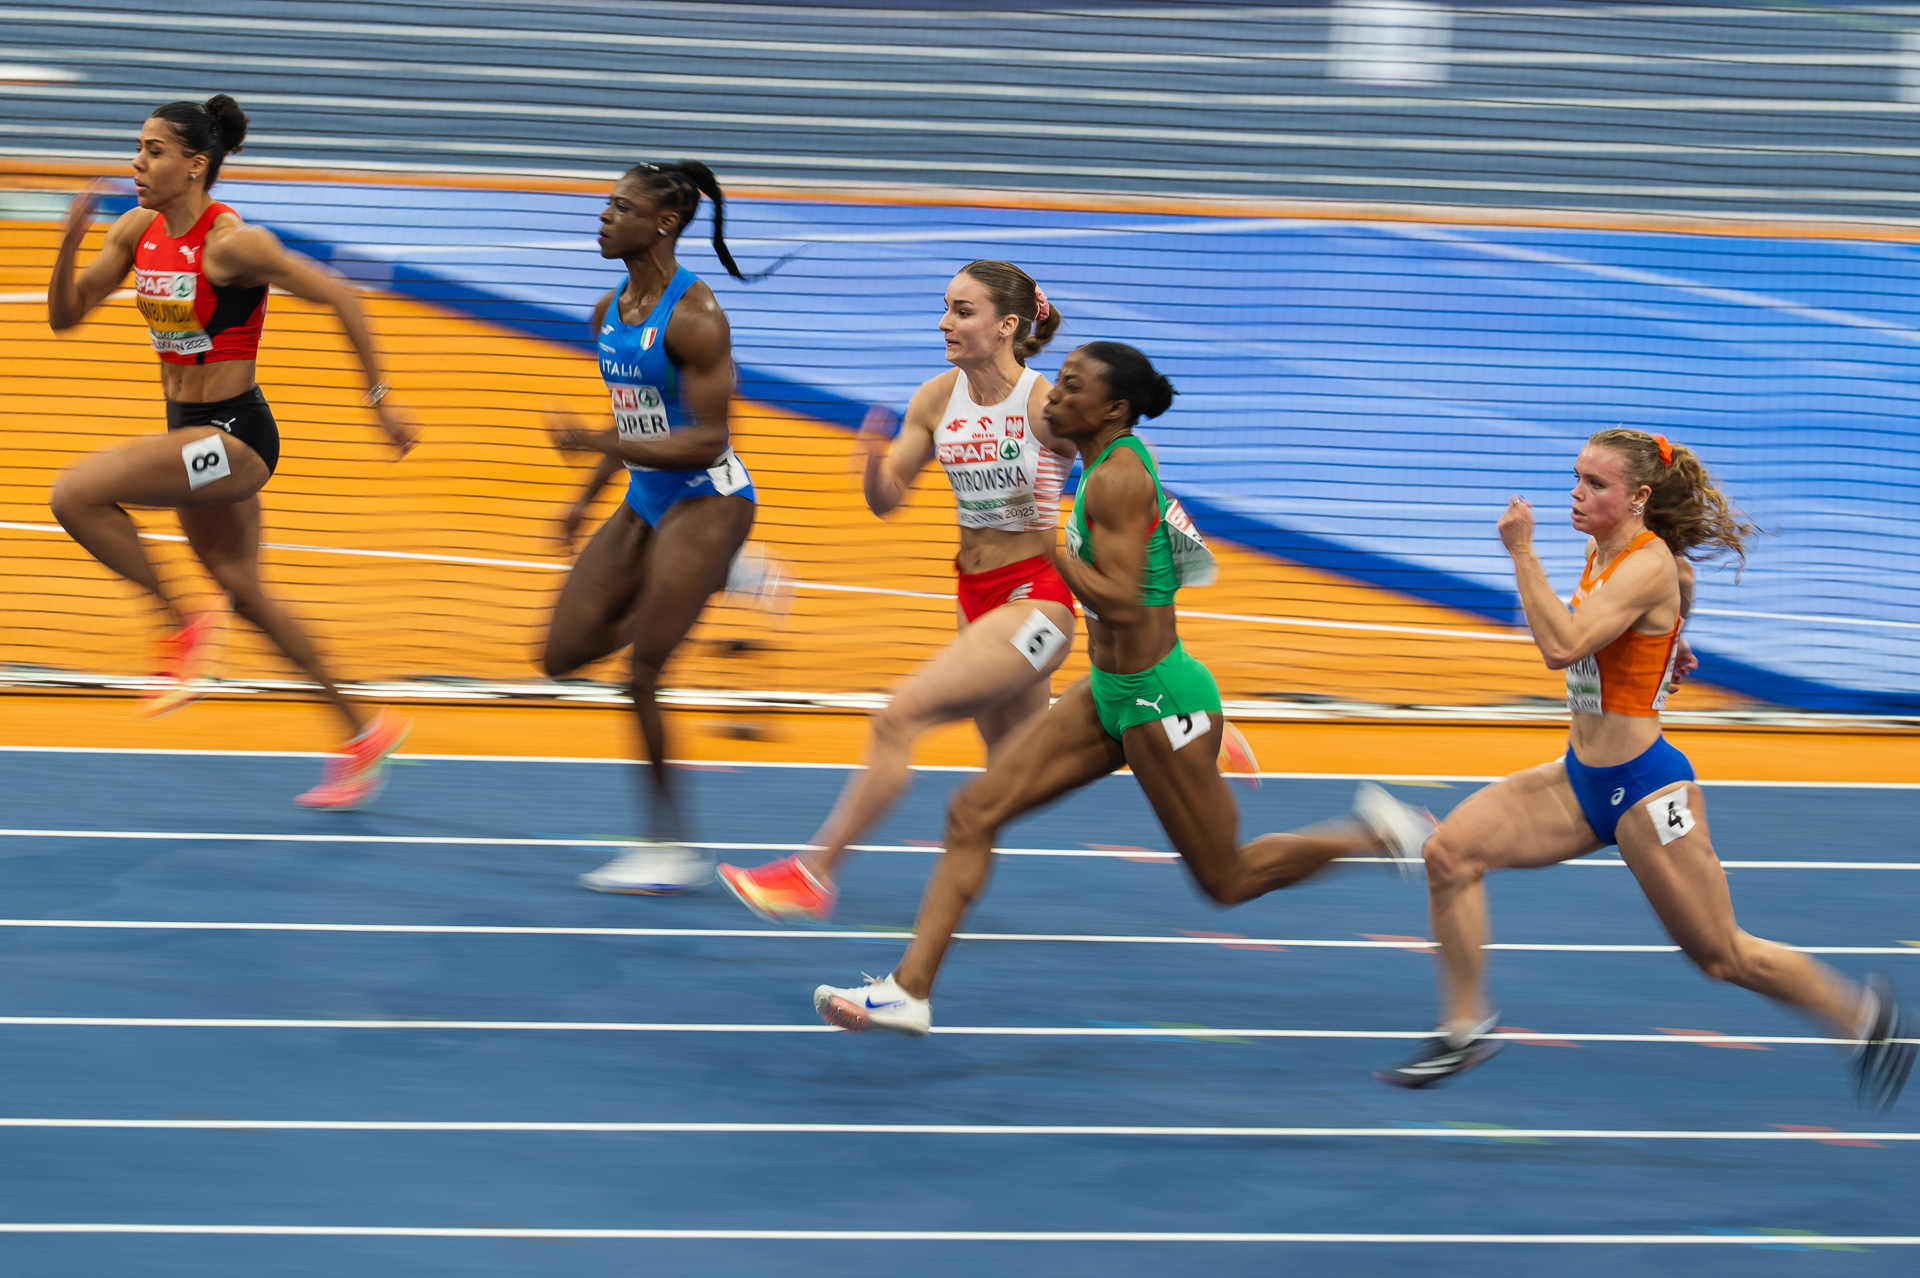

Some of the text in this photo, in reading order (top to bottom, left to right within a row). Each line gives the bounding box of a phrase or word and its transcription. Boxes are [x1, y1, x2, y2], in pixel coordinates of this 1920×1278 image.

[185, 337, 208, 350] 2025
[602, 358, 642, 379] ITALIA
[191, 452, 220, 472] 8
[938, 442, 997, 464] SPAR
[1027, 626, 1054, 655] 6
[1668, 800, 1684, 829] 4
